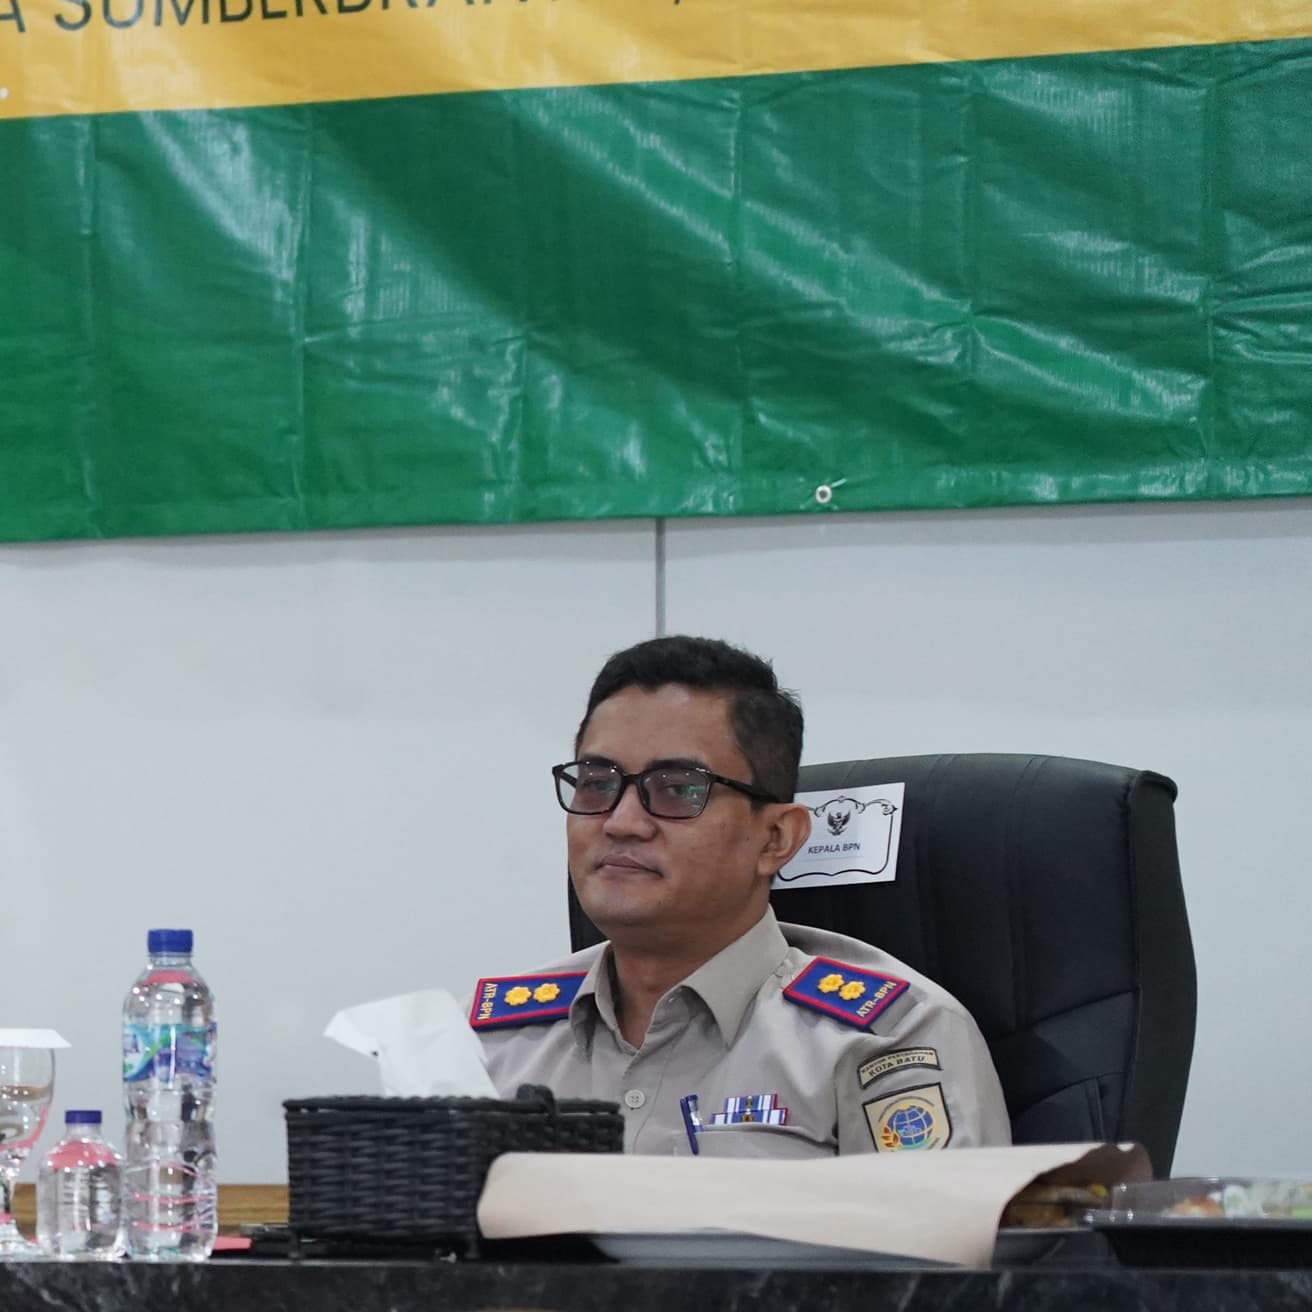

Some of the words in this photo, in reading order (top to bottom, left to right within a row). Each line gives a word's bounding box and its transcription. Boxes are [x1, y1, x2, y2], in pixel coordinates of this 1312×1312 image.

[807, 844, 841, 855] KEPALA
[842, 842, 861, 852] BPN
[477, 982, 498, 1020] ATR-BPN
[856, 981, 897, 1018] ATR-BPN
[868, 1062, 894, 1077] KOTA
[896, 1055, 925, 1065] BATU
